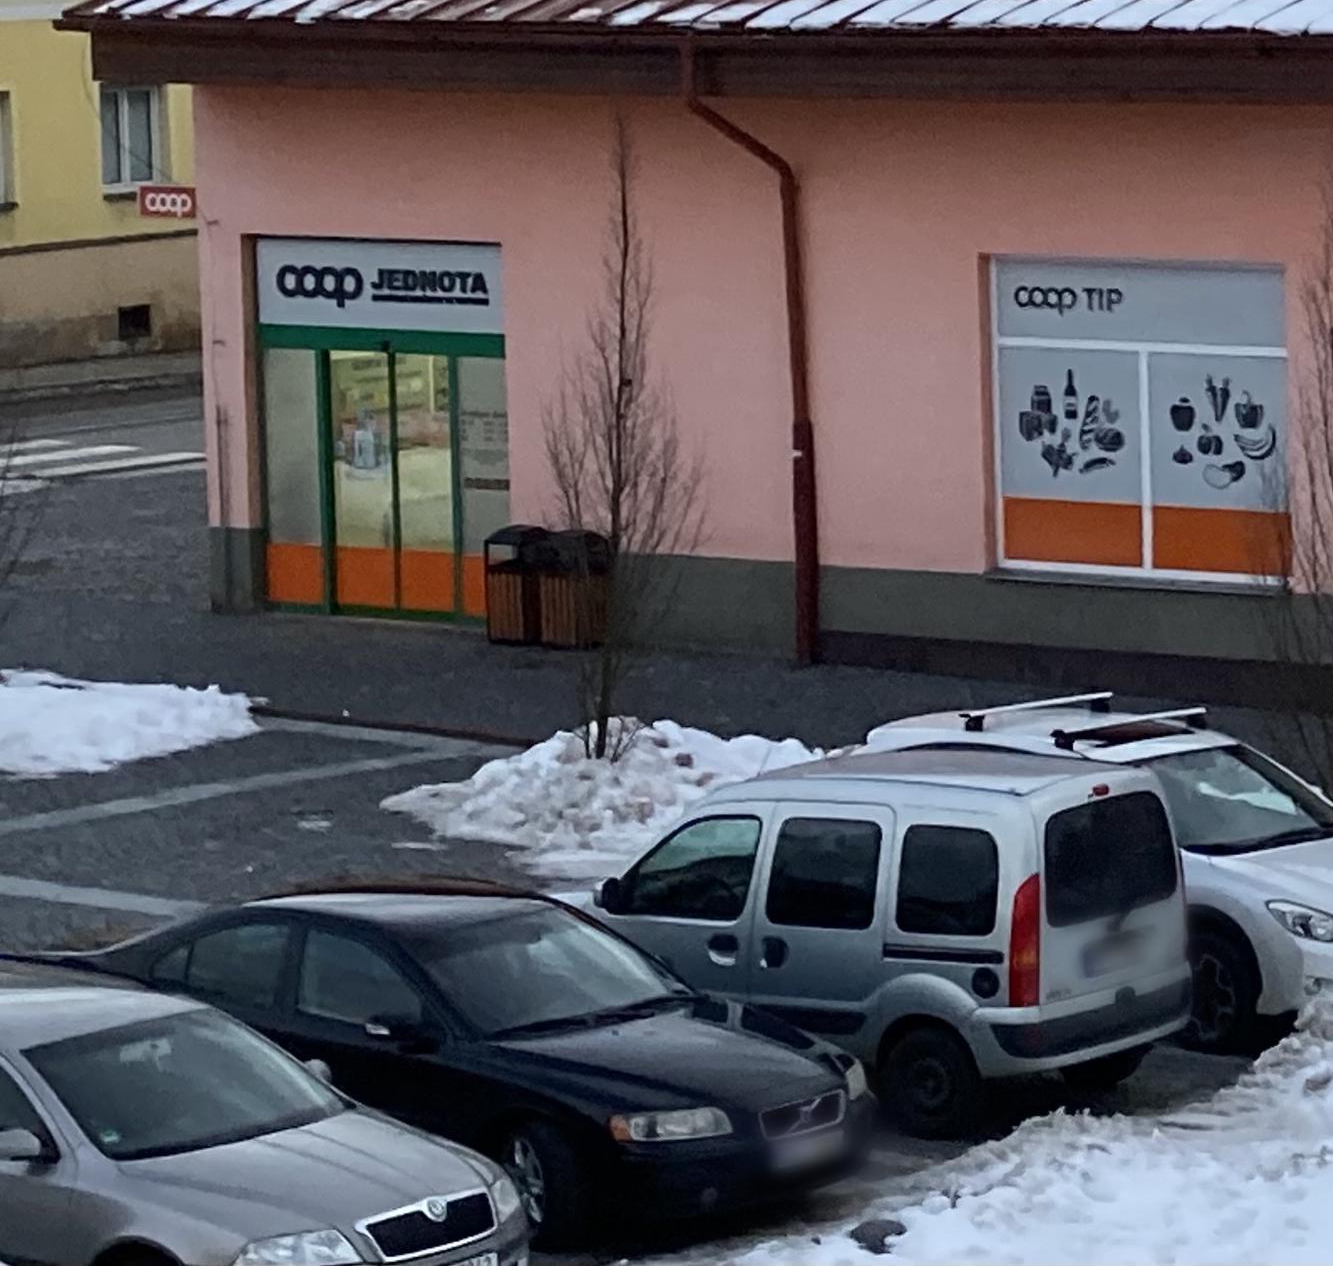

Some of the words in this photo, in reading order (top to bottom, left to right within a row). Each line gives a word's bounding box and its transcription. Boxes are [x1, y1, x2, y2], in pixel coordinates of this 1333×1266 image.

[145, 193, 192, 217] coop
[276, 265, 364, 308] coop
[370, 268, 489, 294] JEDNOTA
[1014, 285, 1077, 317] coop
[1081, 287, 1123, 312] TIP
